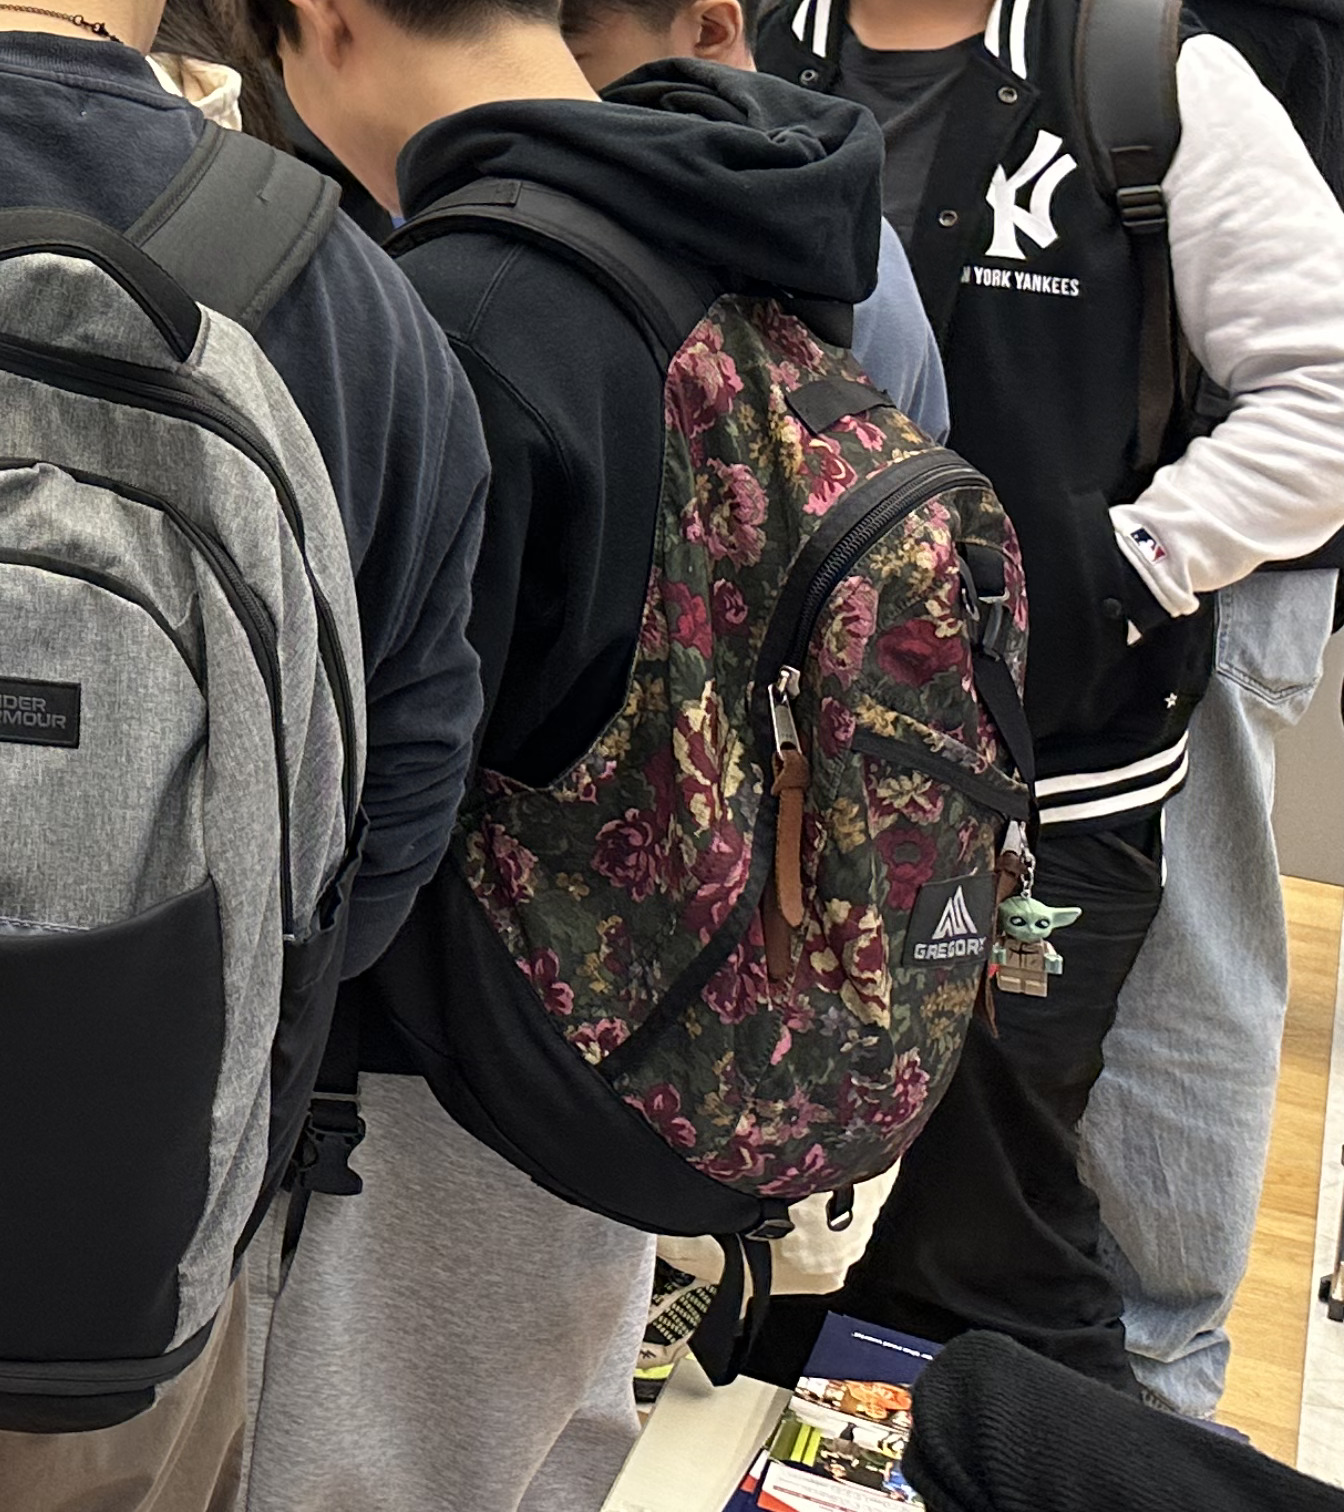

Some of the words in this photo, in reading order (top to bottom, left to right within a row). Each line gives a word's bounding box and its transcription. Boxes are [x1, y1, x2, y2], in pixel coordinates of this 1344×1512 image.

[973, 266, 1012, 288] YORK
[1014, 271, 1080, 297] YANKEES
[914, 937, 987, 959] GREGORY
